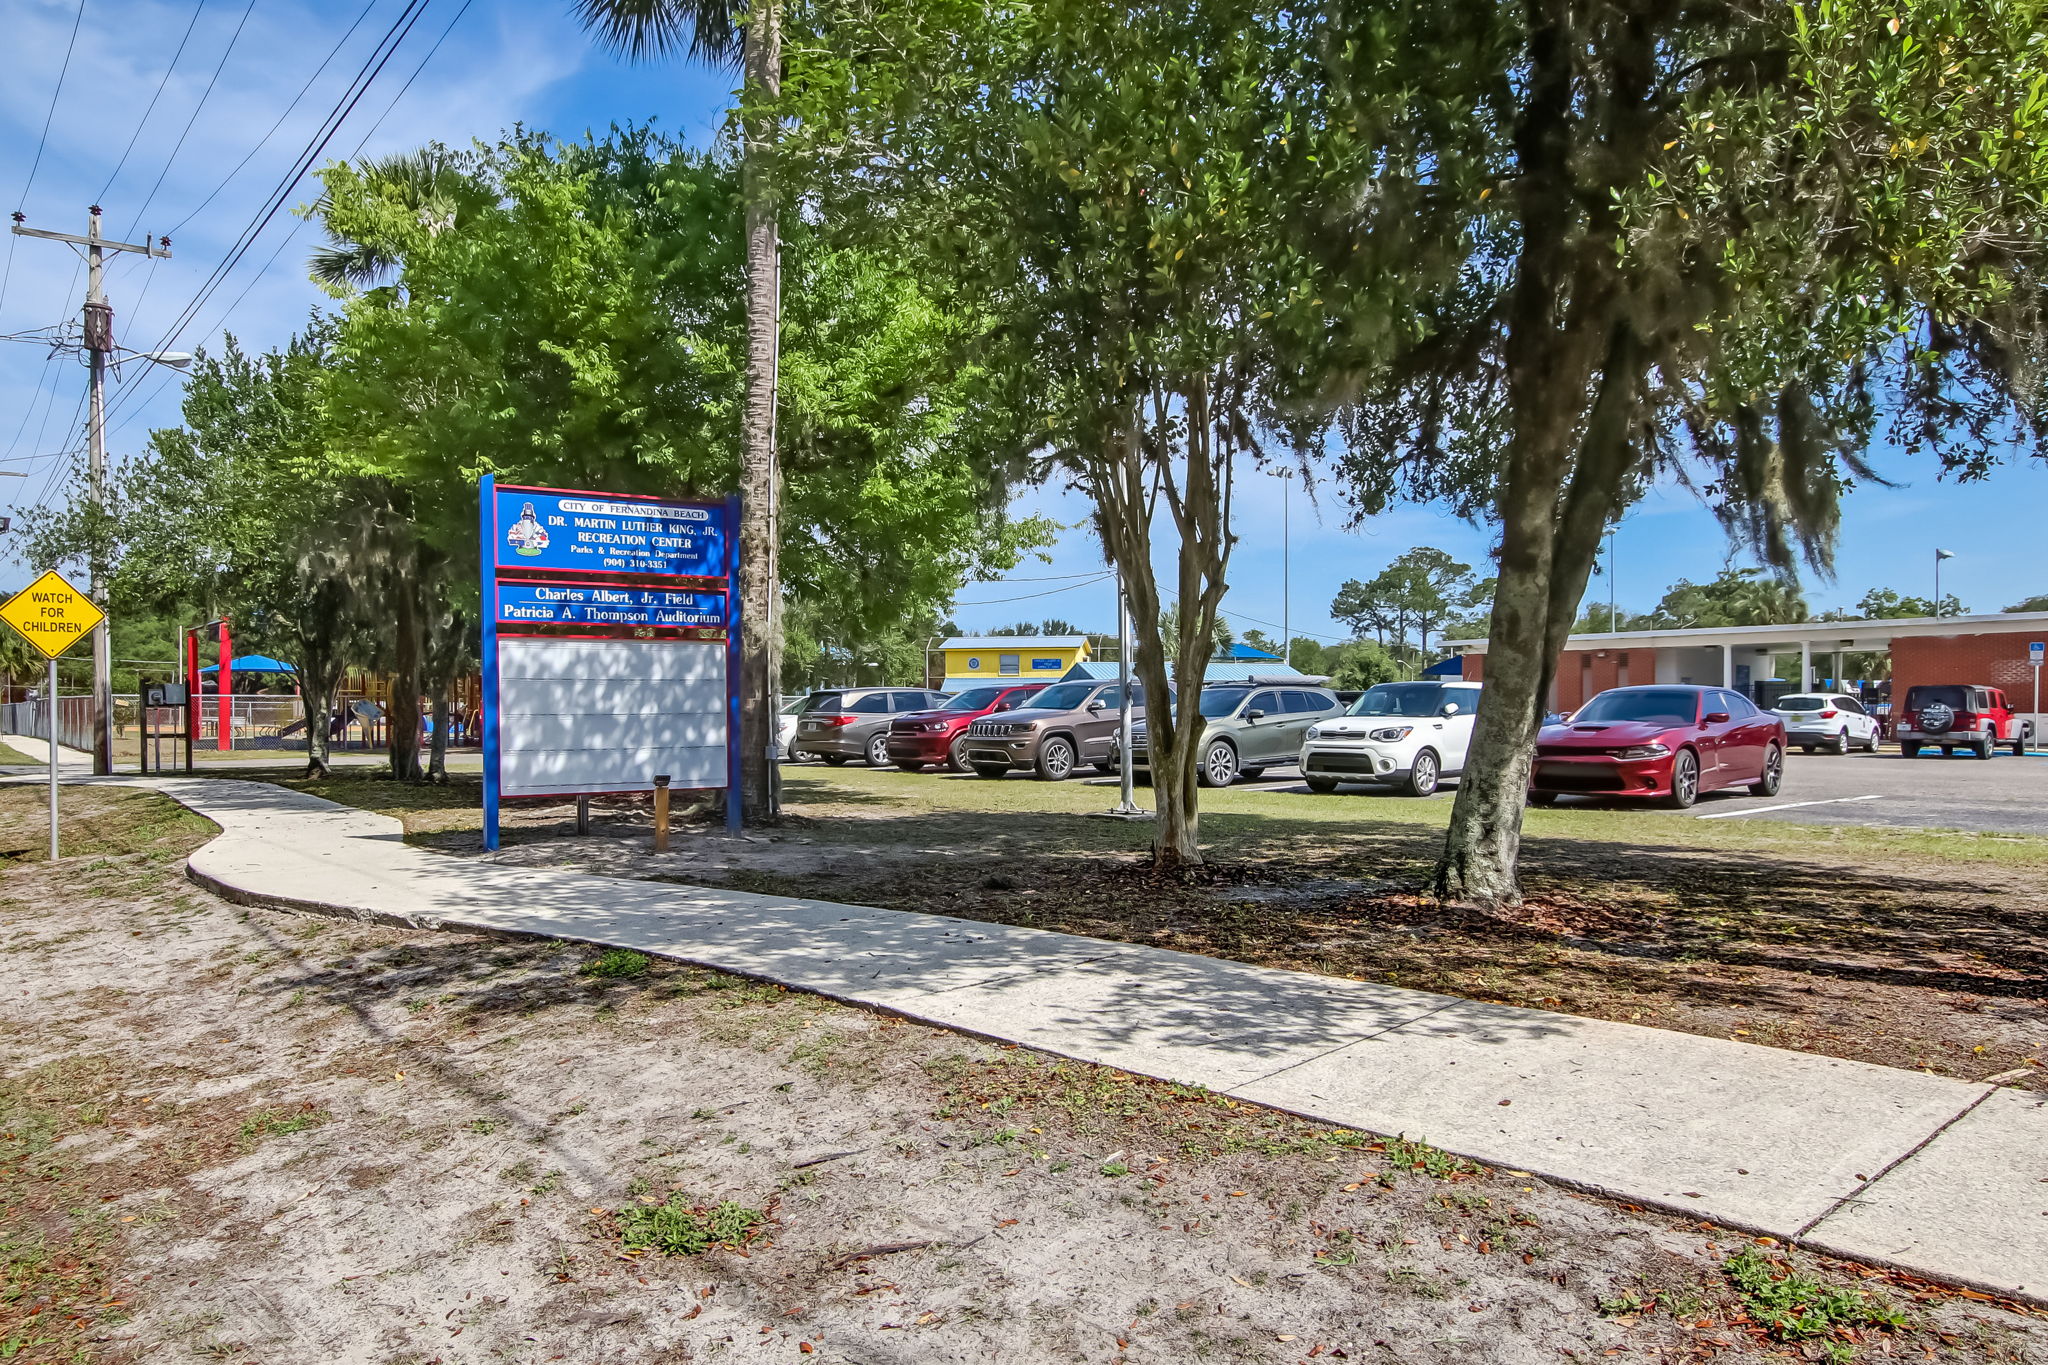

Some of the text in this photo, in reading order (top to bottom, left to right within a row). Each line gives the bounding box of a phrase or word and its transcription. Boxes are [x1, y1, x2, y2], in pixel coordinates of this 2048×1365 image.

[563, 502, 704, 519] CITY OF FERNANDINA BEACH
[548, 515, 568, 527] DR.
[574, 517, 616, 530] MARTIN
[622, 520, 663, 533] LUTHER
[702, 526, 718, 537] JR.
[577, 531, 692, 549] RECREATION CENTER
[570, 544, 698, 560] Parks & Recreation Department
[603, 557, 667, 569] (904) 310-3351
[31, 592, 73, 604] WATCH
[535, 587, 693, 605] Charles Albert, Jr. Field
[40, 607, 65, 618] FOR
[504, 604, 720, 623] Patricia A. Thompson Auditorium
[22, 621, 82, 634] CHILDREN
